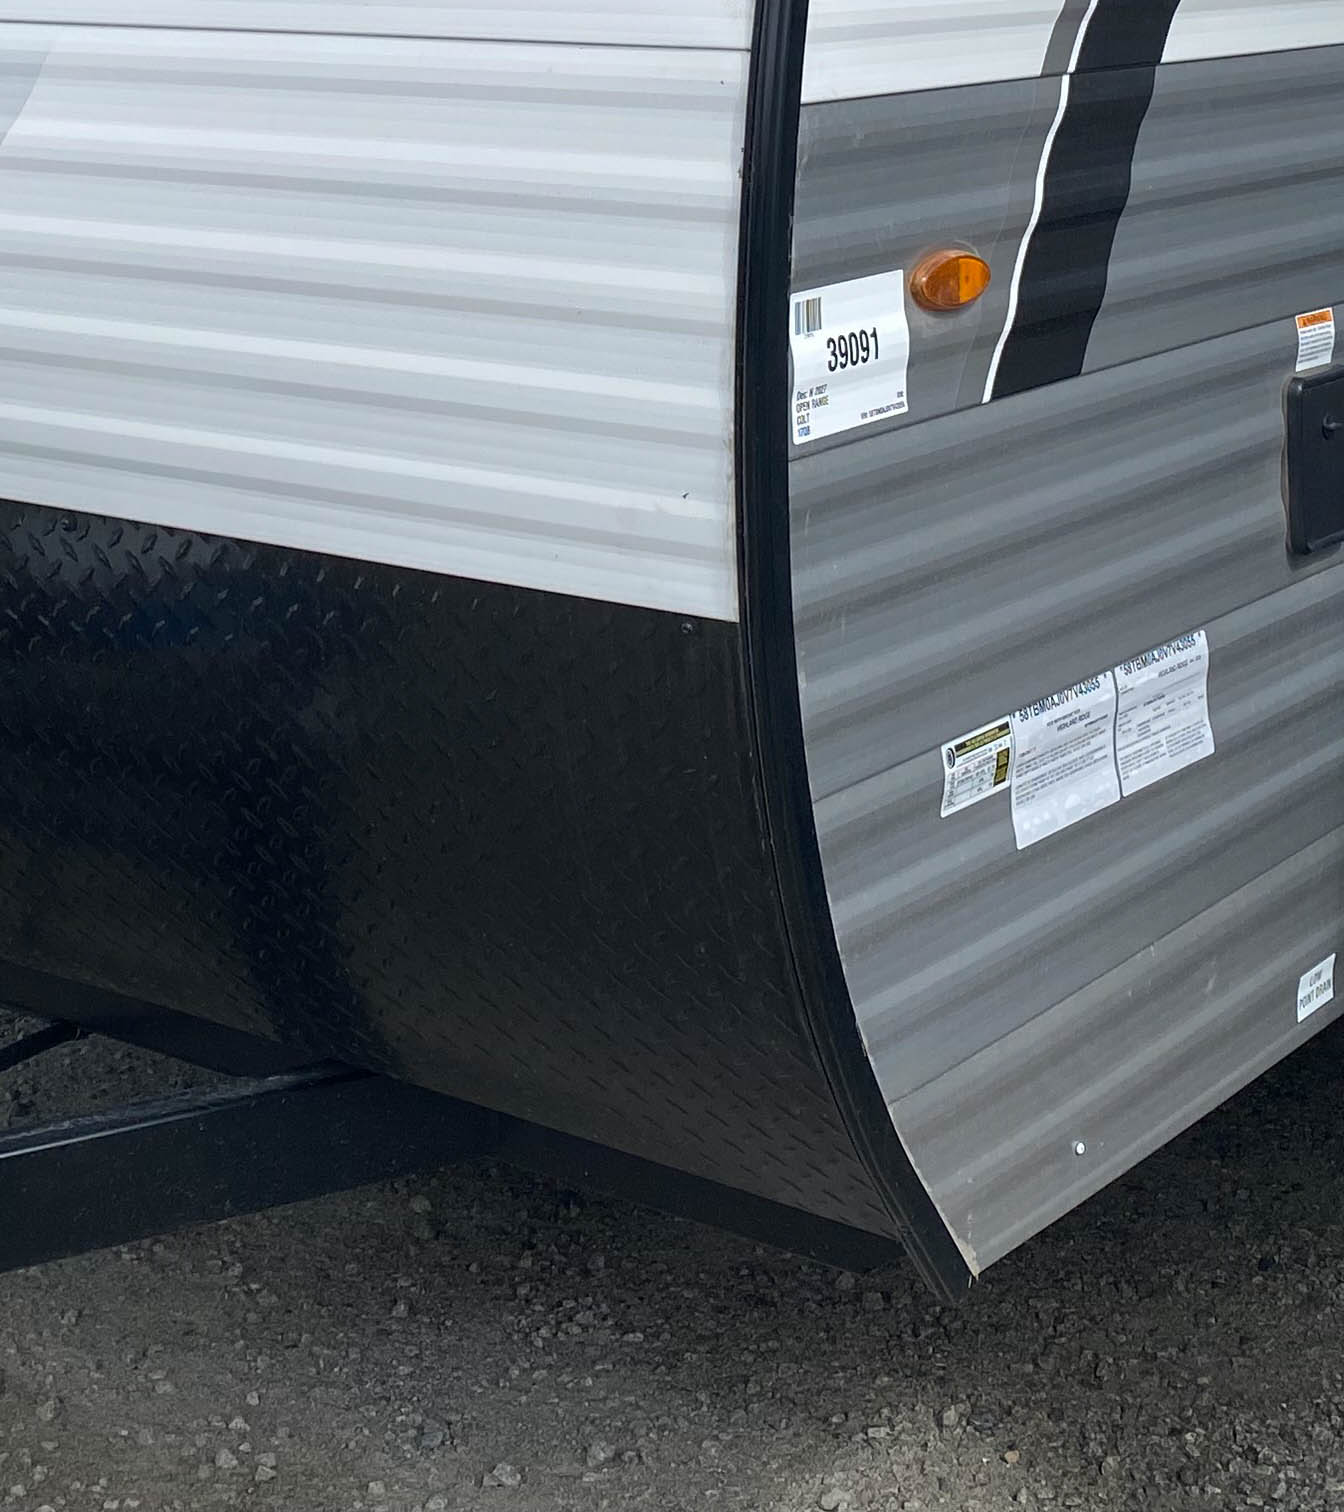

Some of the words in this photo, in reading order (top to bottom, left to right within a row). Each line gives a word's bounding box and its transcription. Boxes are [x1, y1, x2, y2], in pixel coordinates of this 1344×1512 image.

[826, 326, 880, 373] 39091
[1309, 968, 1323, 987] LOW
[1299, 989, 1315, 1011] POINT
[1316, 978, 1331, 999] DRAIN
